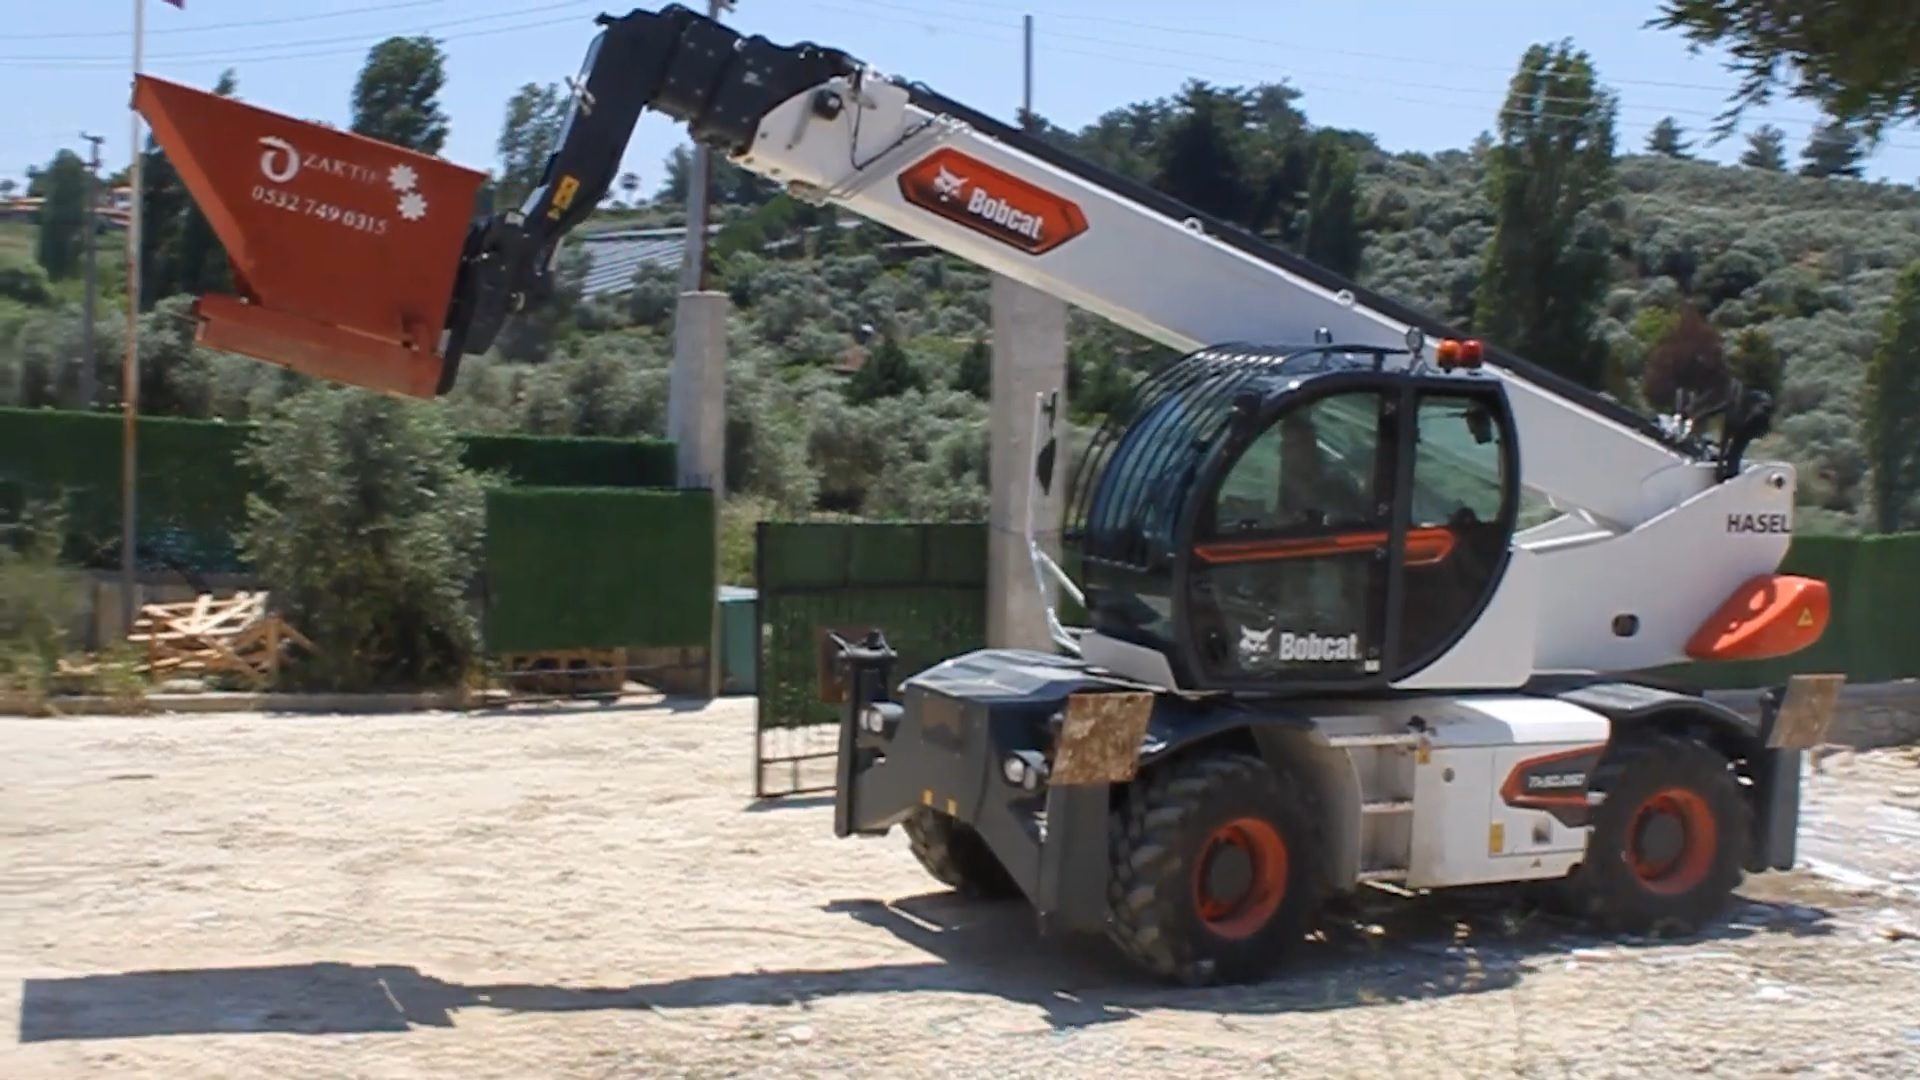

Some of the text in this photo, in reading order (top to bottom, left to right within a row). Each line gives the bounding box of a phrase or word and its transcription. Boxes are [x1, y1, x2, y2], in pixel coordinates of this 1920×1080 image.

[252, 185, 388, 235] 0532 749 0315
[967, 187, 1044, 239] Bobcat
[1726, 514, 1792, 533] HASEL
[1279, 632, 1359, 661] Bobcat
